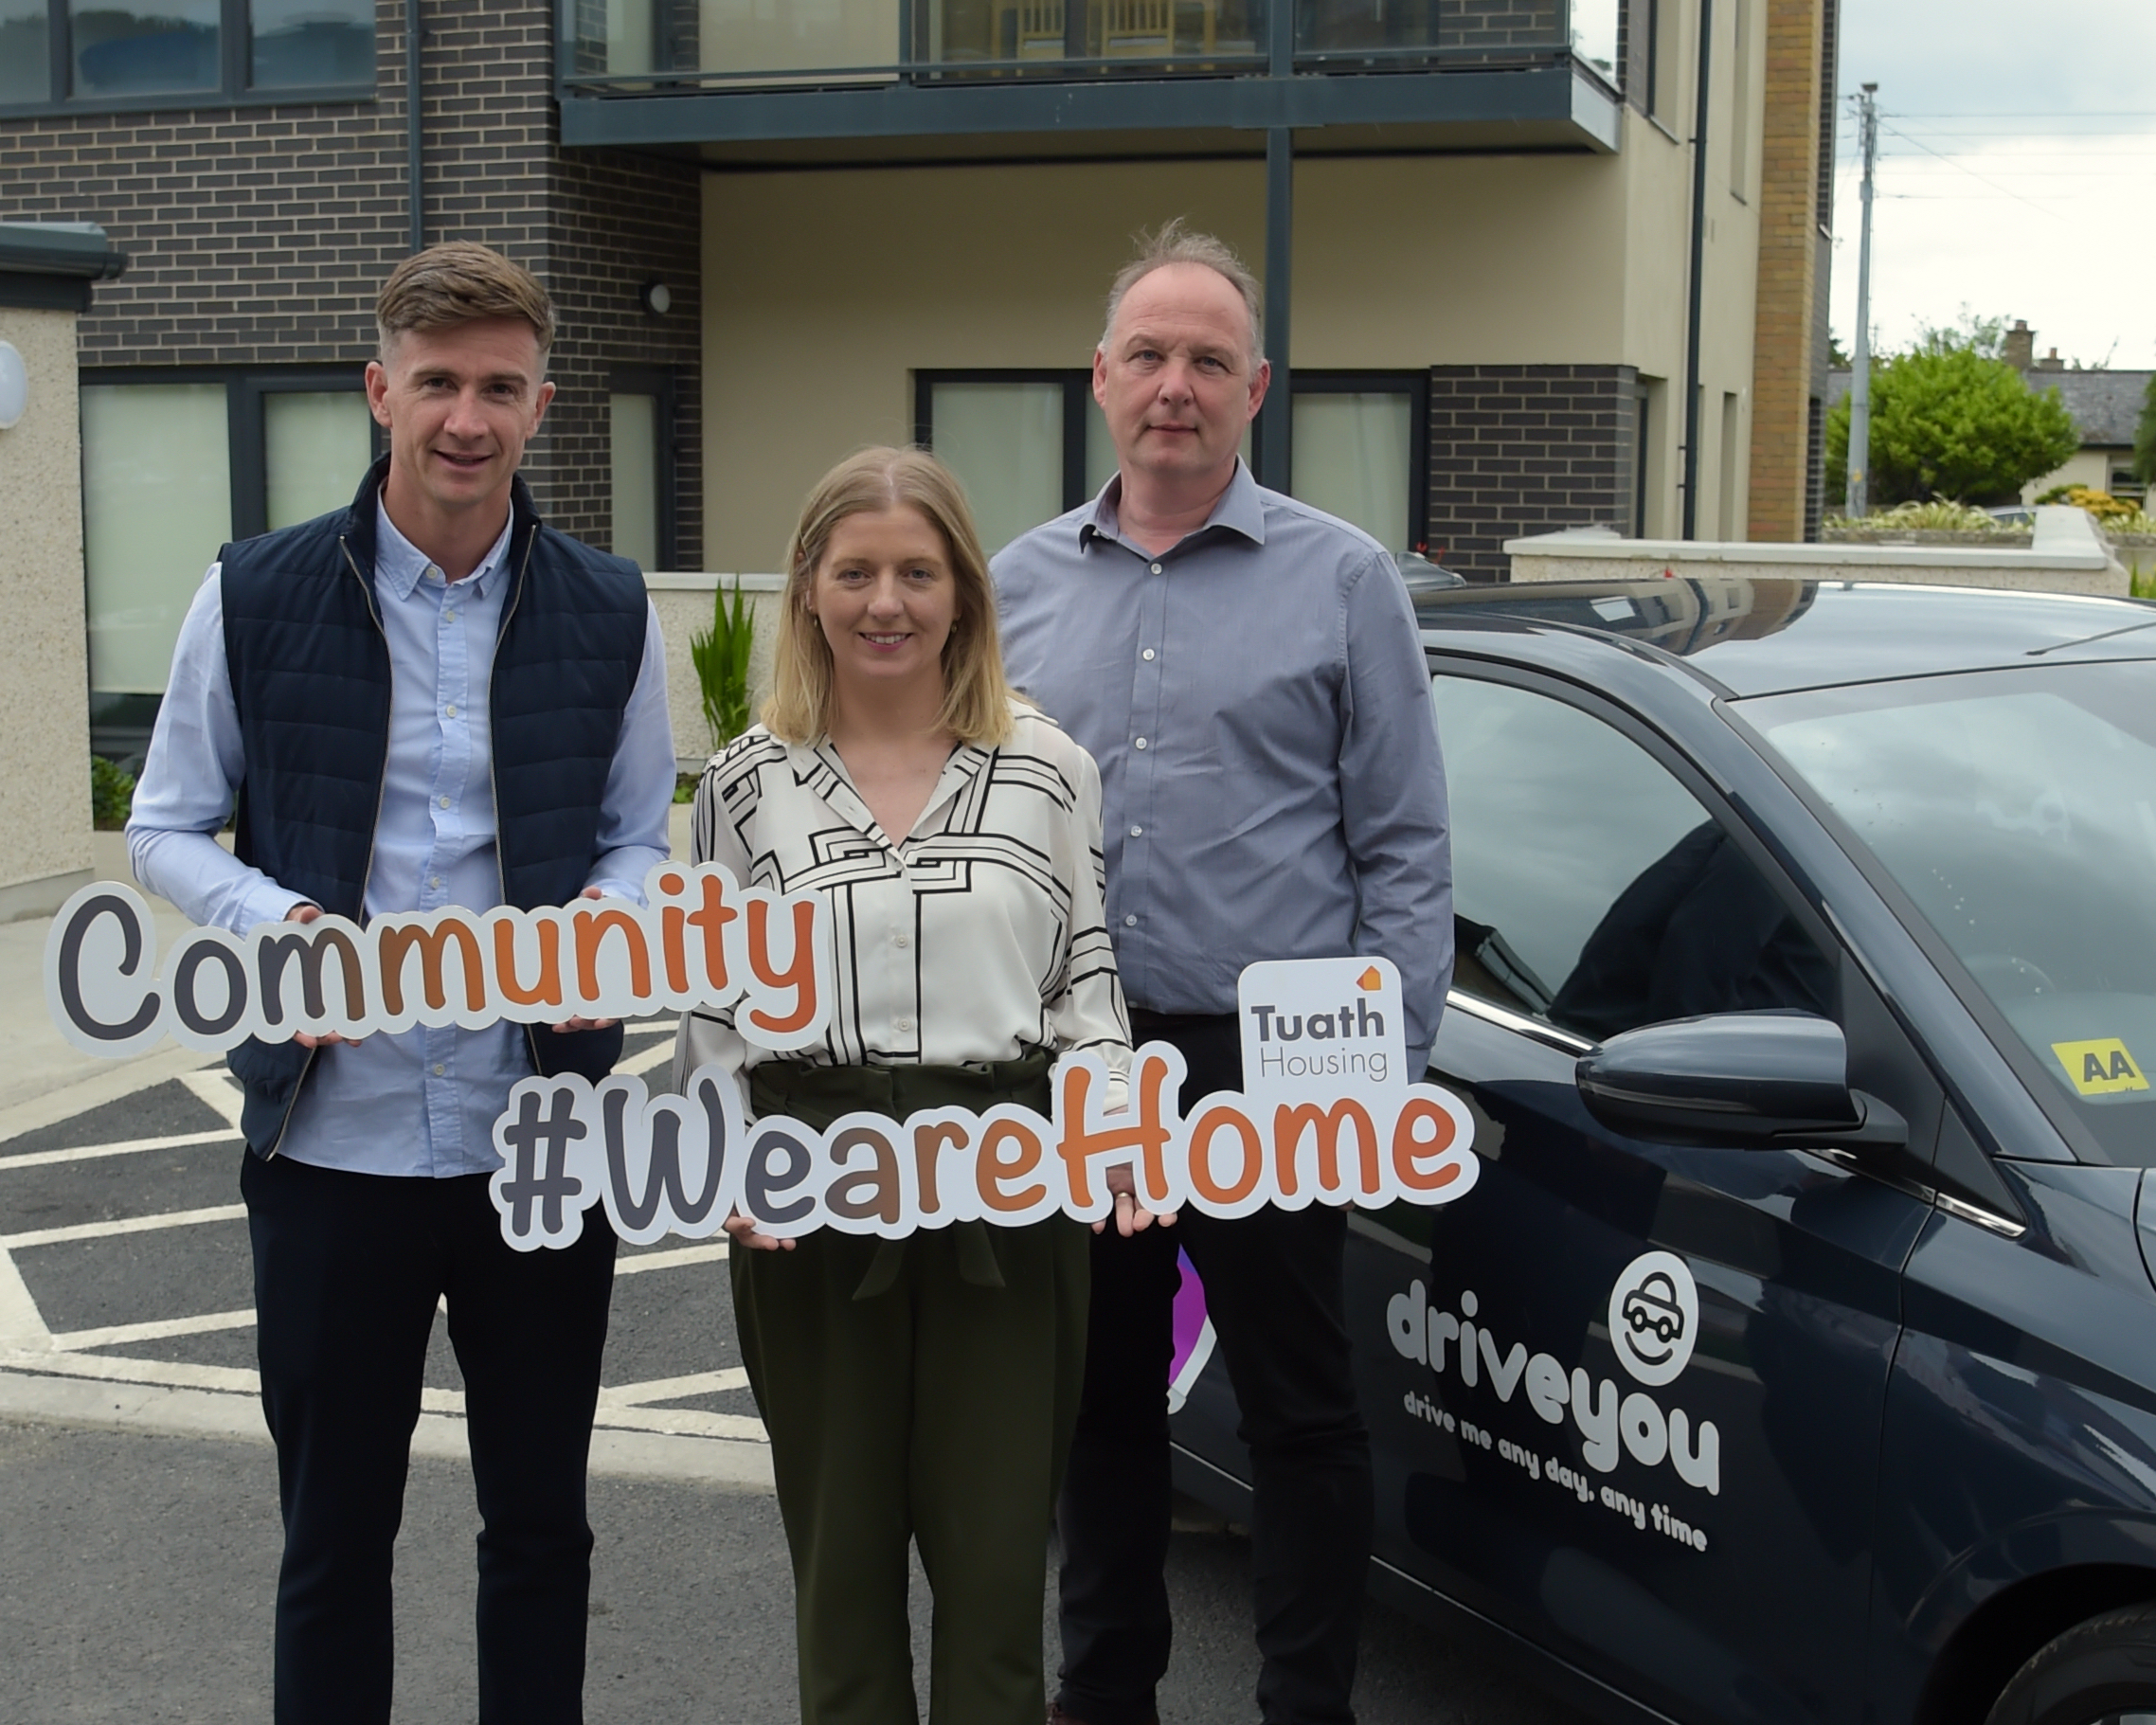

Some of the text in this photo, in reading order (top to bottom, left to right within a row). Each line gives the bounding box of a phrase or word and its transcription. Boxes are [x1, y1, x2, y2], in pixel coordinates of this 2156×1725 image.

[59, 873, 816, 1040] Community
[1250, 997, 1385, 1042] Tuath
[503, 1055, 1461, 1233] #WeareHome
[1260, 1047, 1388, 1082] Housing
[2084, 1051, 2136, 1082] AA
[1387, 1279, 1719, 1496] driveyou
[1404, 1391, 1455, 1432] drive
[1461, 1419, 1492, 1450] me
[1498, 1438, 1540, 1480] any
[1601, 1485, 1646, 1530] any
[1650, 1502, 1708, 1552] time
